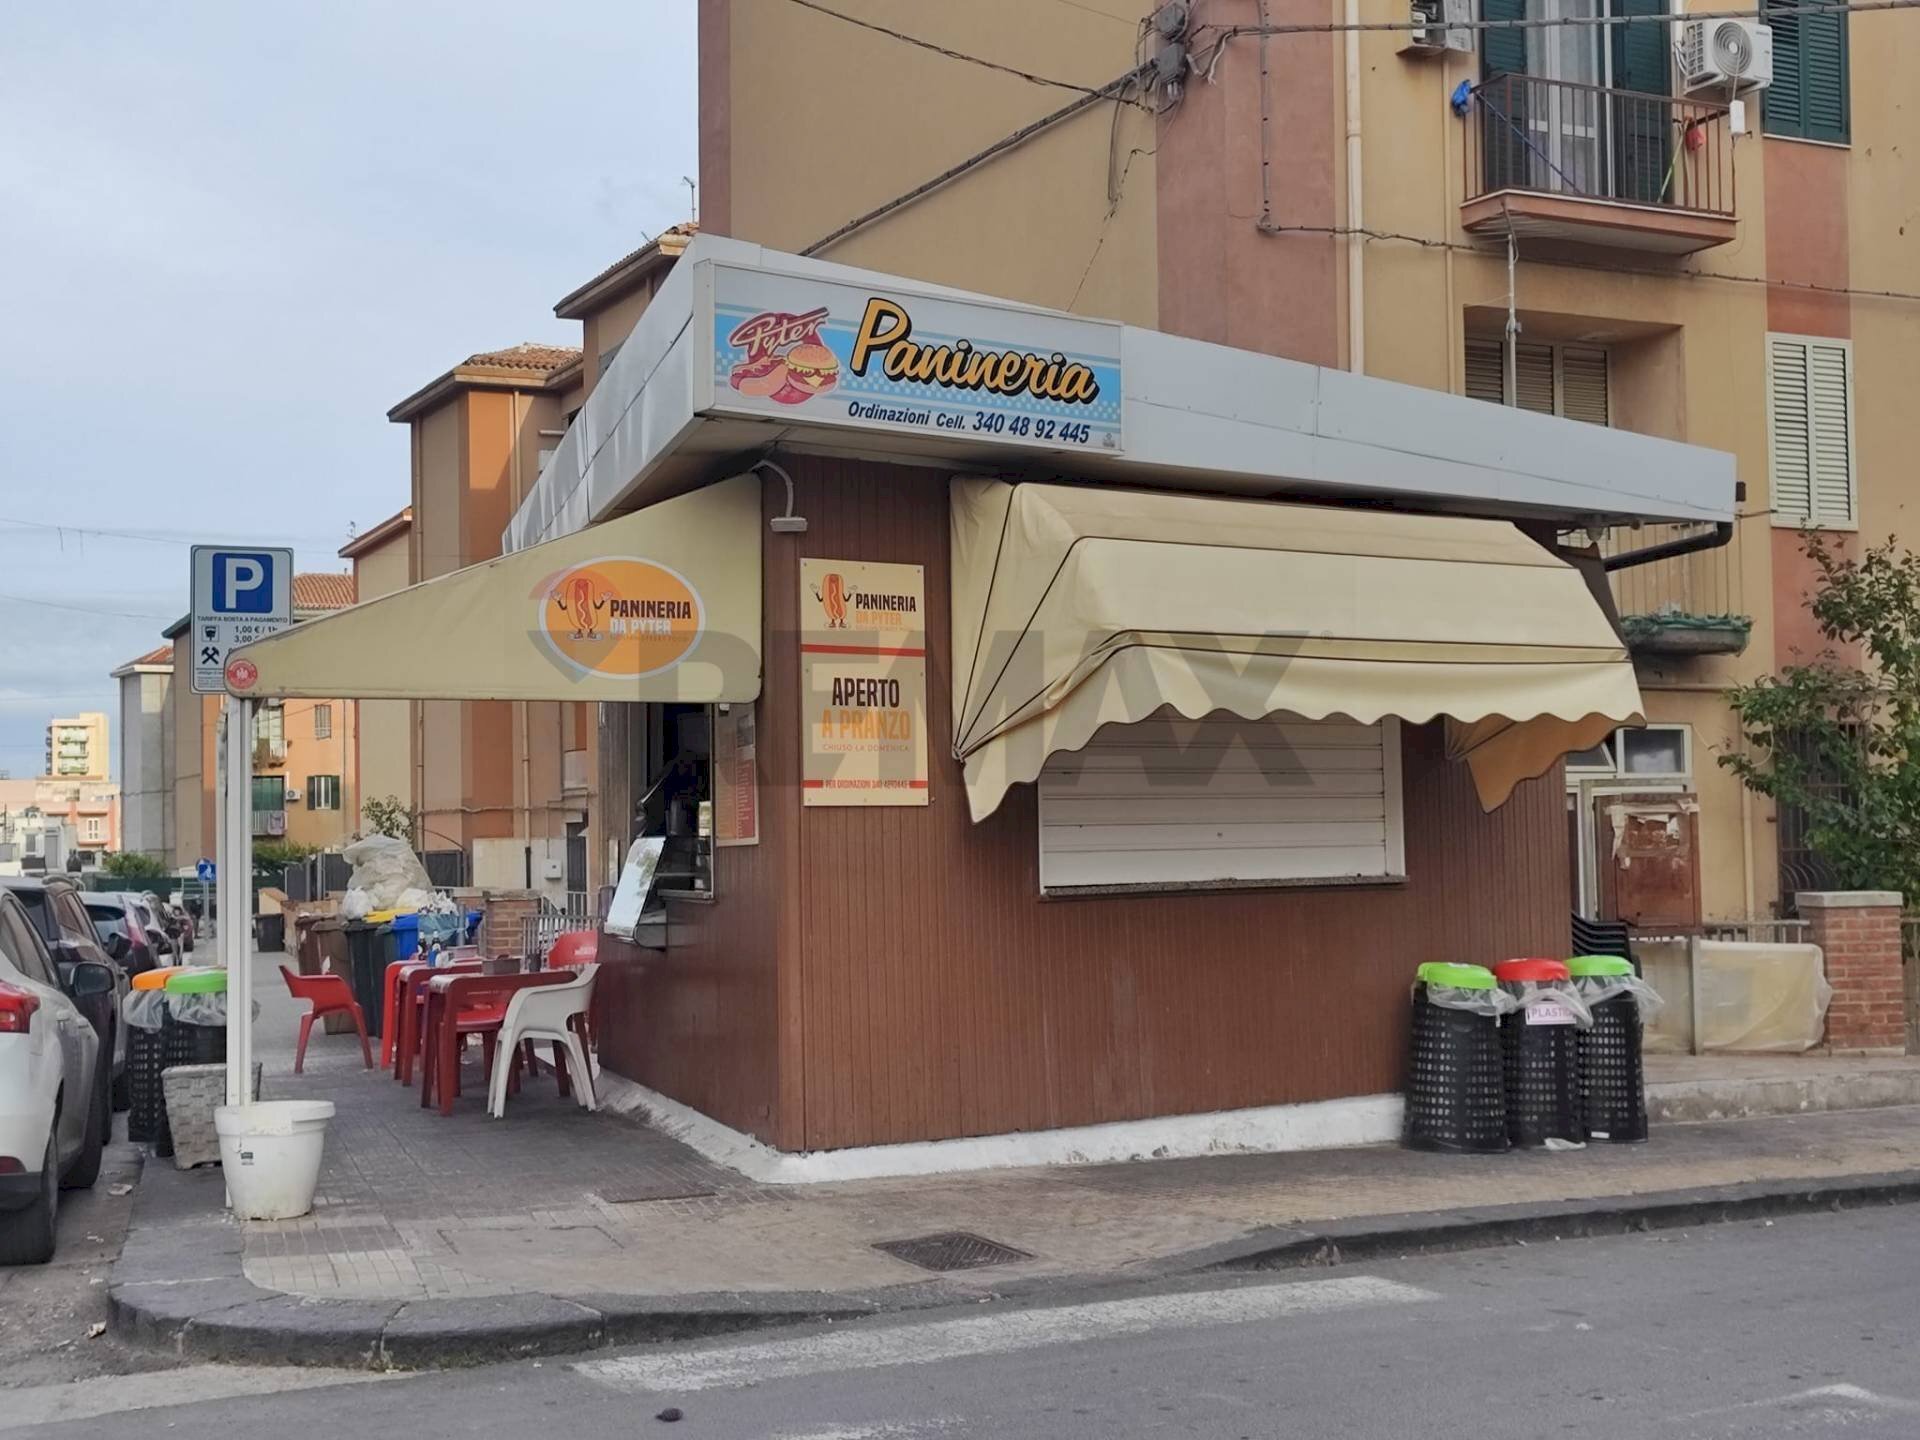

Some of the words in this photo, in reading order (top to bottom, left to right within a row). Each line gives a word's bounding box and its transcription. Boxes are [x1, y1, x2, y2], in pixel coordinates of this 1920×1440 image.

[850, 297, 1100, 404] Panineria
[848, 401, 931, 426] Ordinazioni
[936, 412, 965, 430] Cell.
[973, 411, 1004, 433] 340
[1009, 416, 1028, 437] 48
[1034, 419, 1056, 440] 92
[1059, 423, 1090, 444] 445
[225, 557, 264, 609] P
[610, 599, 692, 619] PANINERIA
[855, 593, 917, 612] PANINERIA
[235, 626, 252, 634] 1,00
[609, 618, 627, 635] DA
[631, 618, 672, 635] PYTER
[855, 610, 870, 624] DA
[871, 611, 901, 626] PYTER
[832, 677, 900, 708] APERTO
[822, 708, 833, 739] A
[839, 709, 911, 740] PRANZO
